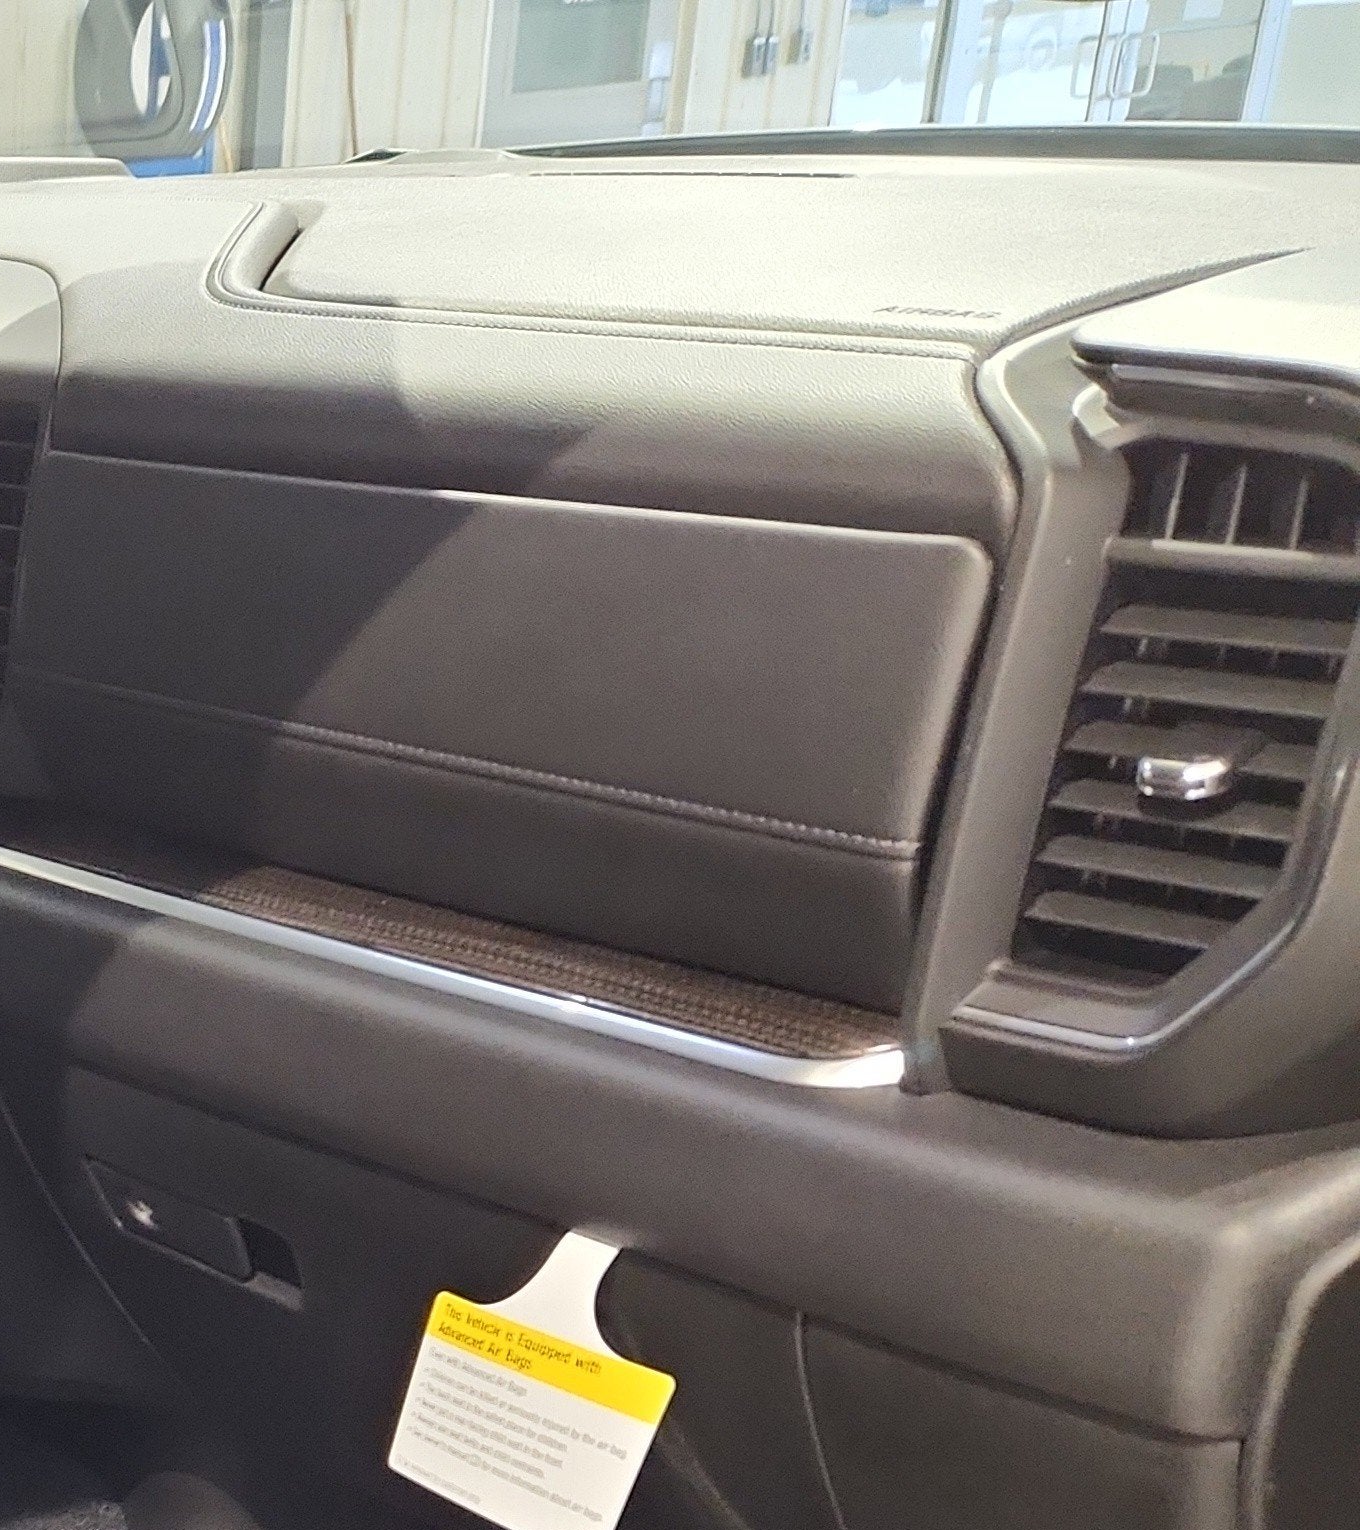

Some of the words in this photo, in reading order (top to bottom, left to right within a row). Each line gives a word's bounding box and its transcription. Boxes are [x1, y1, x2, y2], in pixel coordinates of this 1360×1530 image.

[873, 305, 1002, 319] AIRBAG
[516, 1331, 573, 1365] Equipped
[574, 1354, 603, 1376] with
